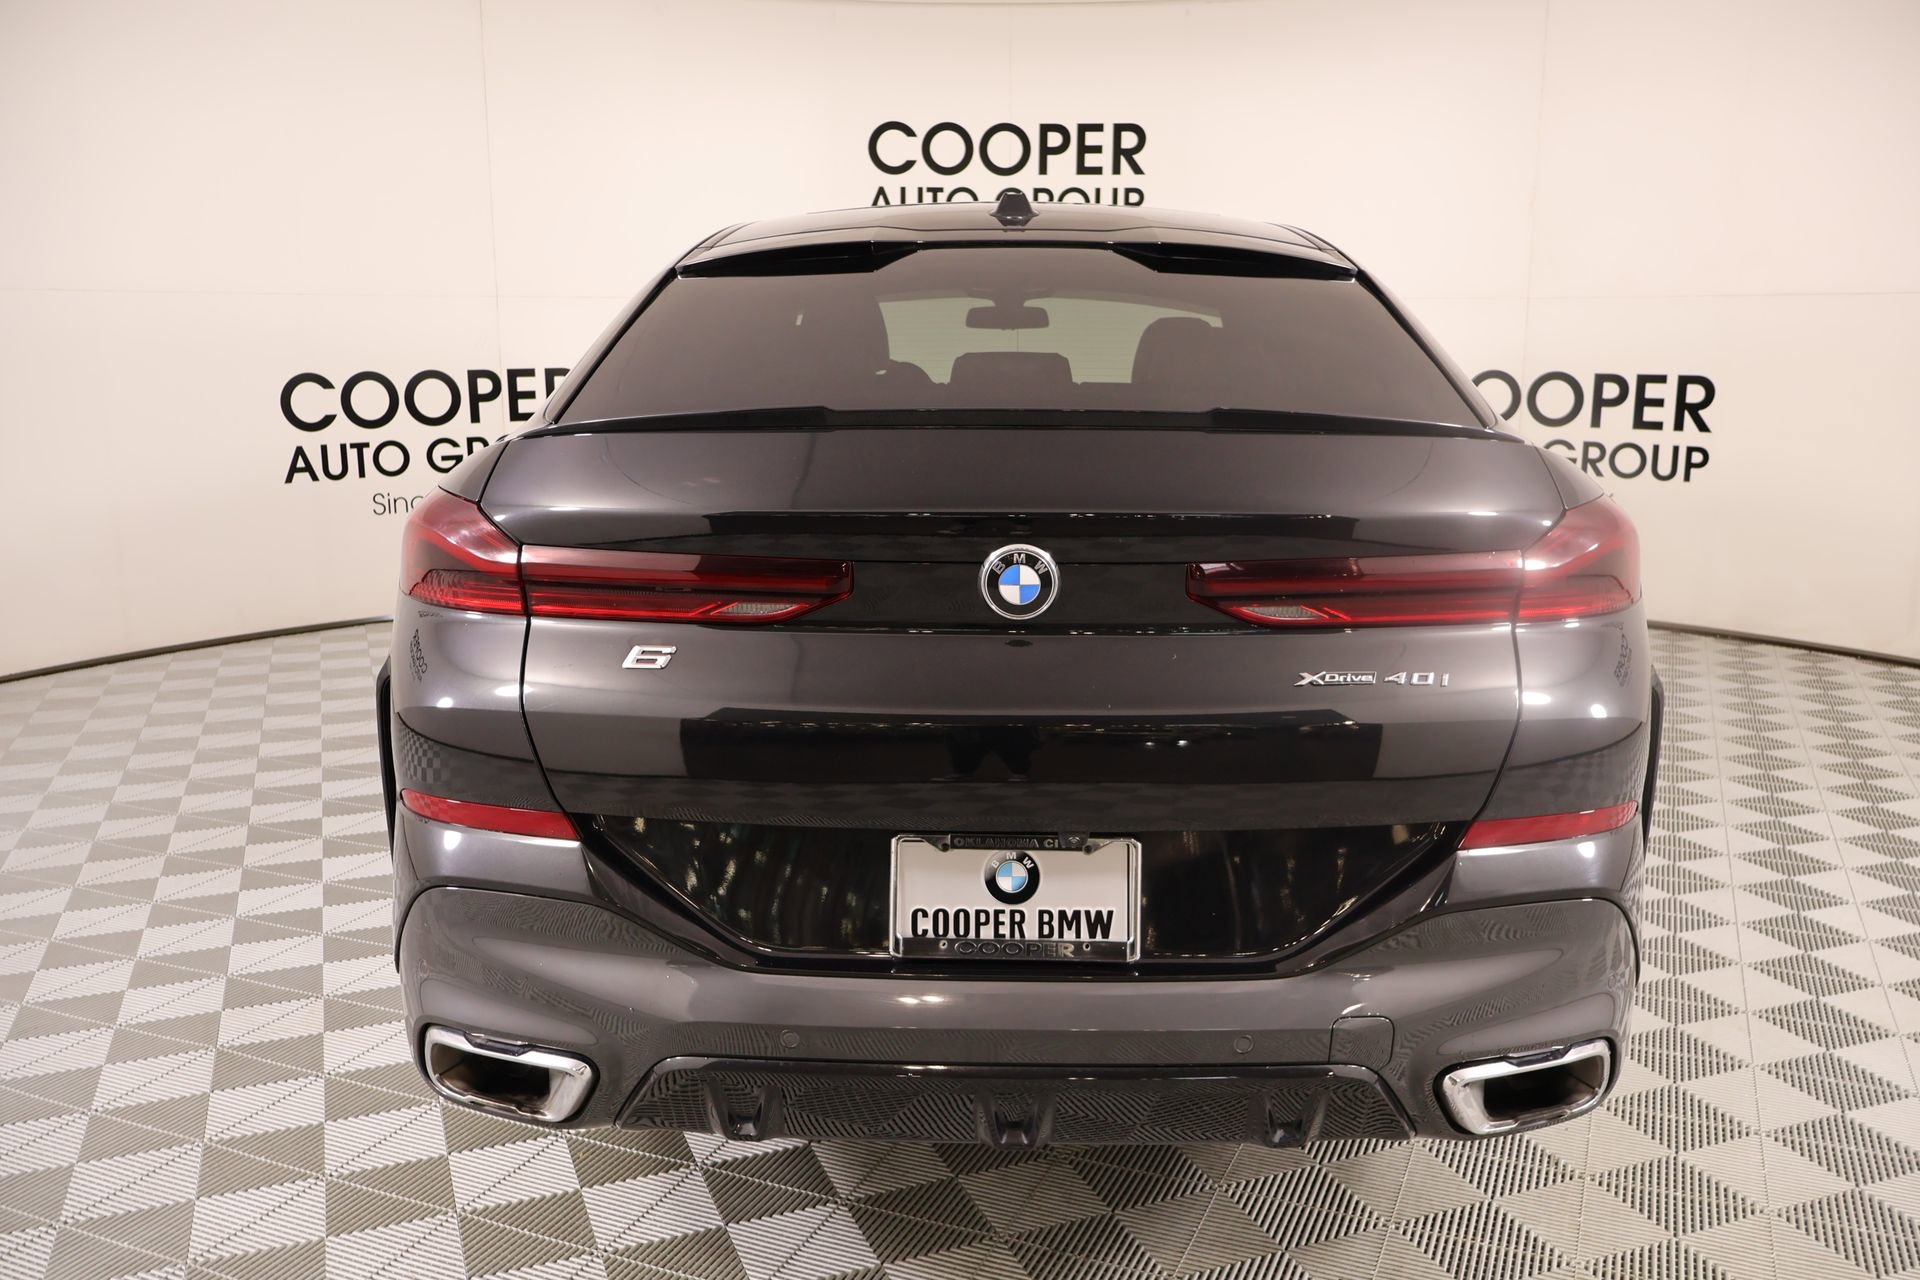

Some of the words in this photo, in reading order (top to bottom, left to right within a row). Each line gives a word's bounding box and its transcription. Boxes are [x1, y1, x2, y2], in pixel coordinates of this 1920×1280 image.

[868, 121, 1147, 176] COOPER
[1472, 370, 1716, 433] OOPER
[284, 440, 410, 484] AUTO
[372, 492, 424, 516] Sinc
[991, 553, 1049, 575] BMW
[622, 645, 677, 669] 6
[991, 851, 1035, 869] BMW
[911, 907, 1026, 939] COOPER
[1038, 909, 1114, 940] BMW
[954, 940, 1075, 958] COOPER
